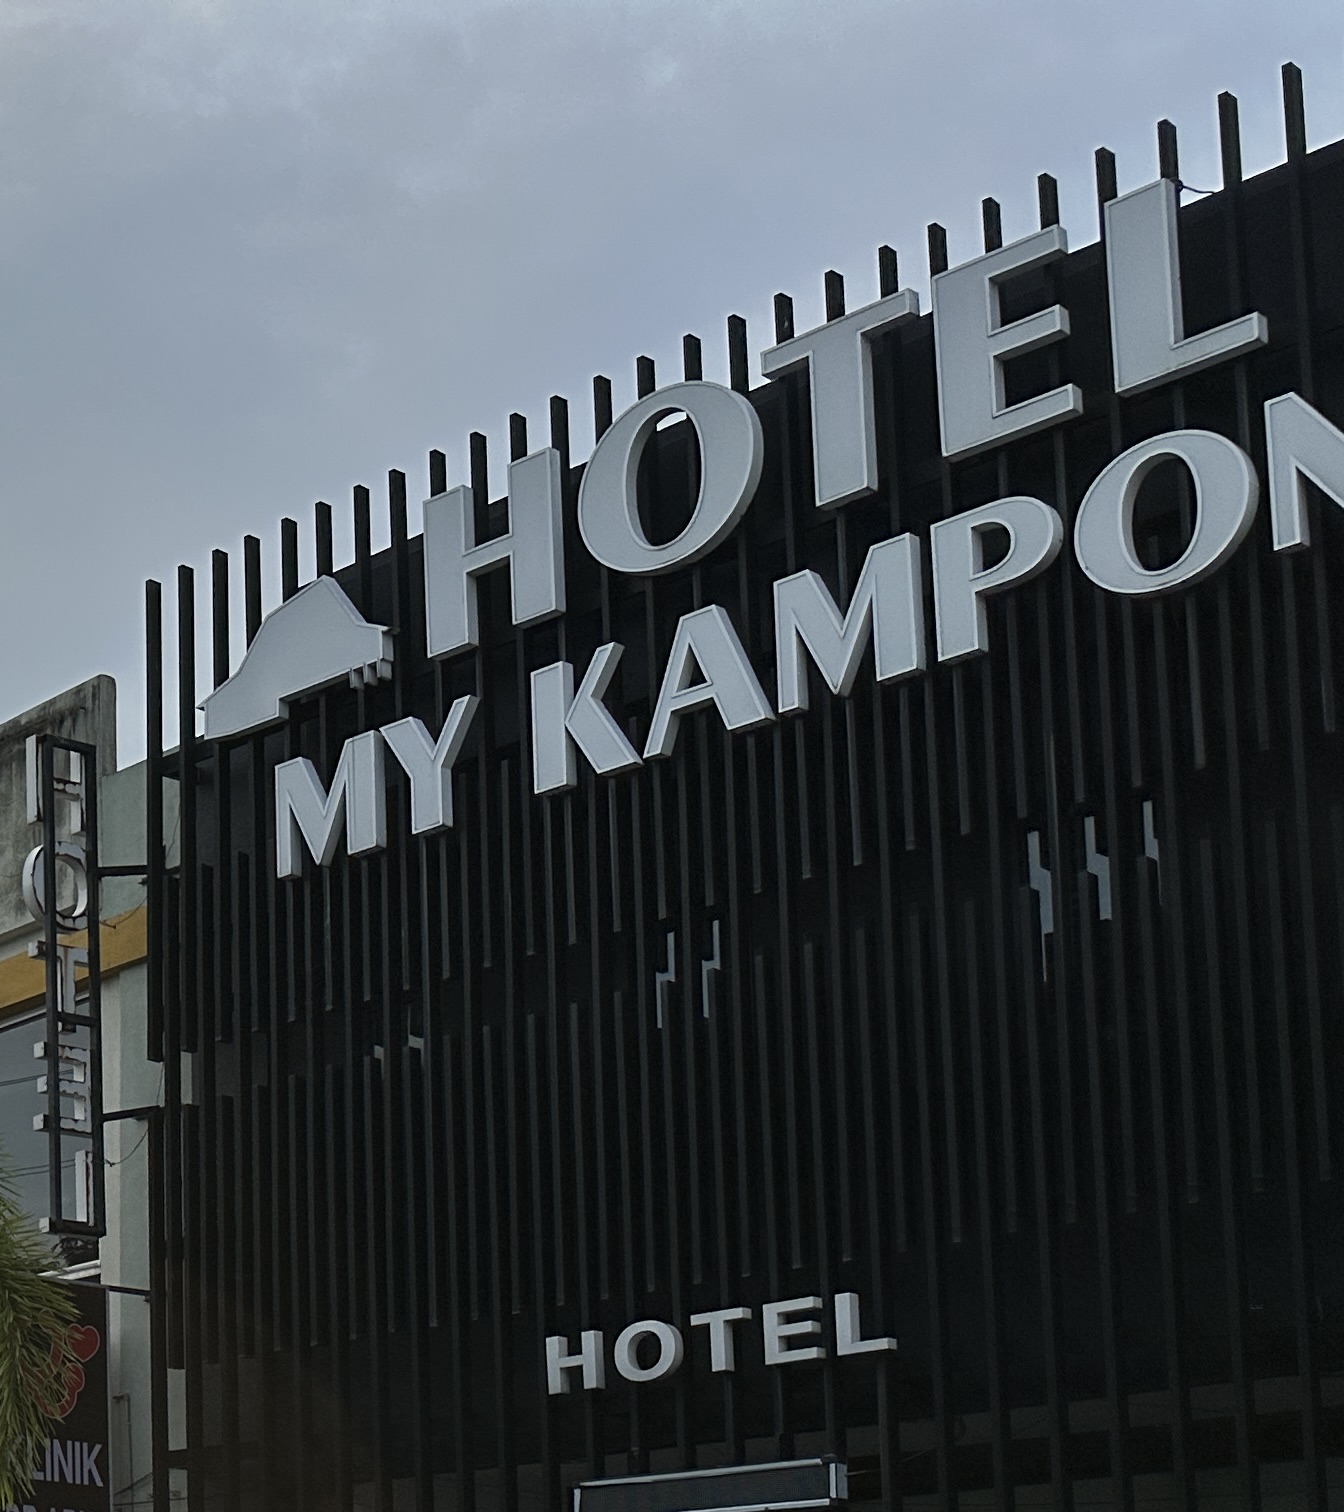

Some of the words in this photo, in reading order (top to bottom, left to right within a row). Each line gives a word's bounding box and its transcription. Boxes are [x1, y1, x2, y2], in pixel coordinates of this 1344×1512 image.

[422, 178, 1268, 660] HOTEL
[274, 694, 478, 880] MY
[545, 1292, 898, 1396] HOTEL
